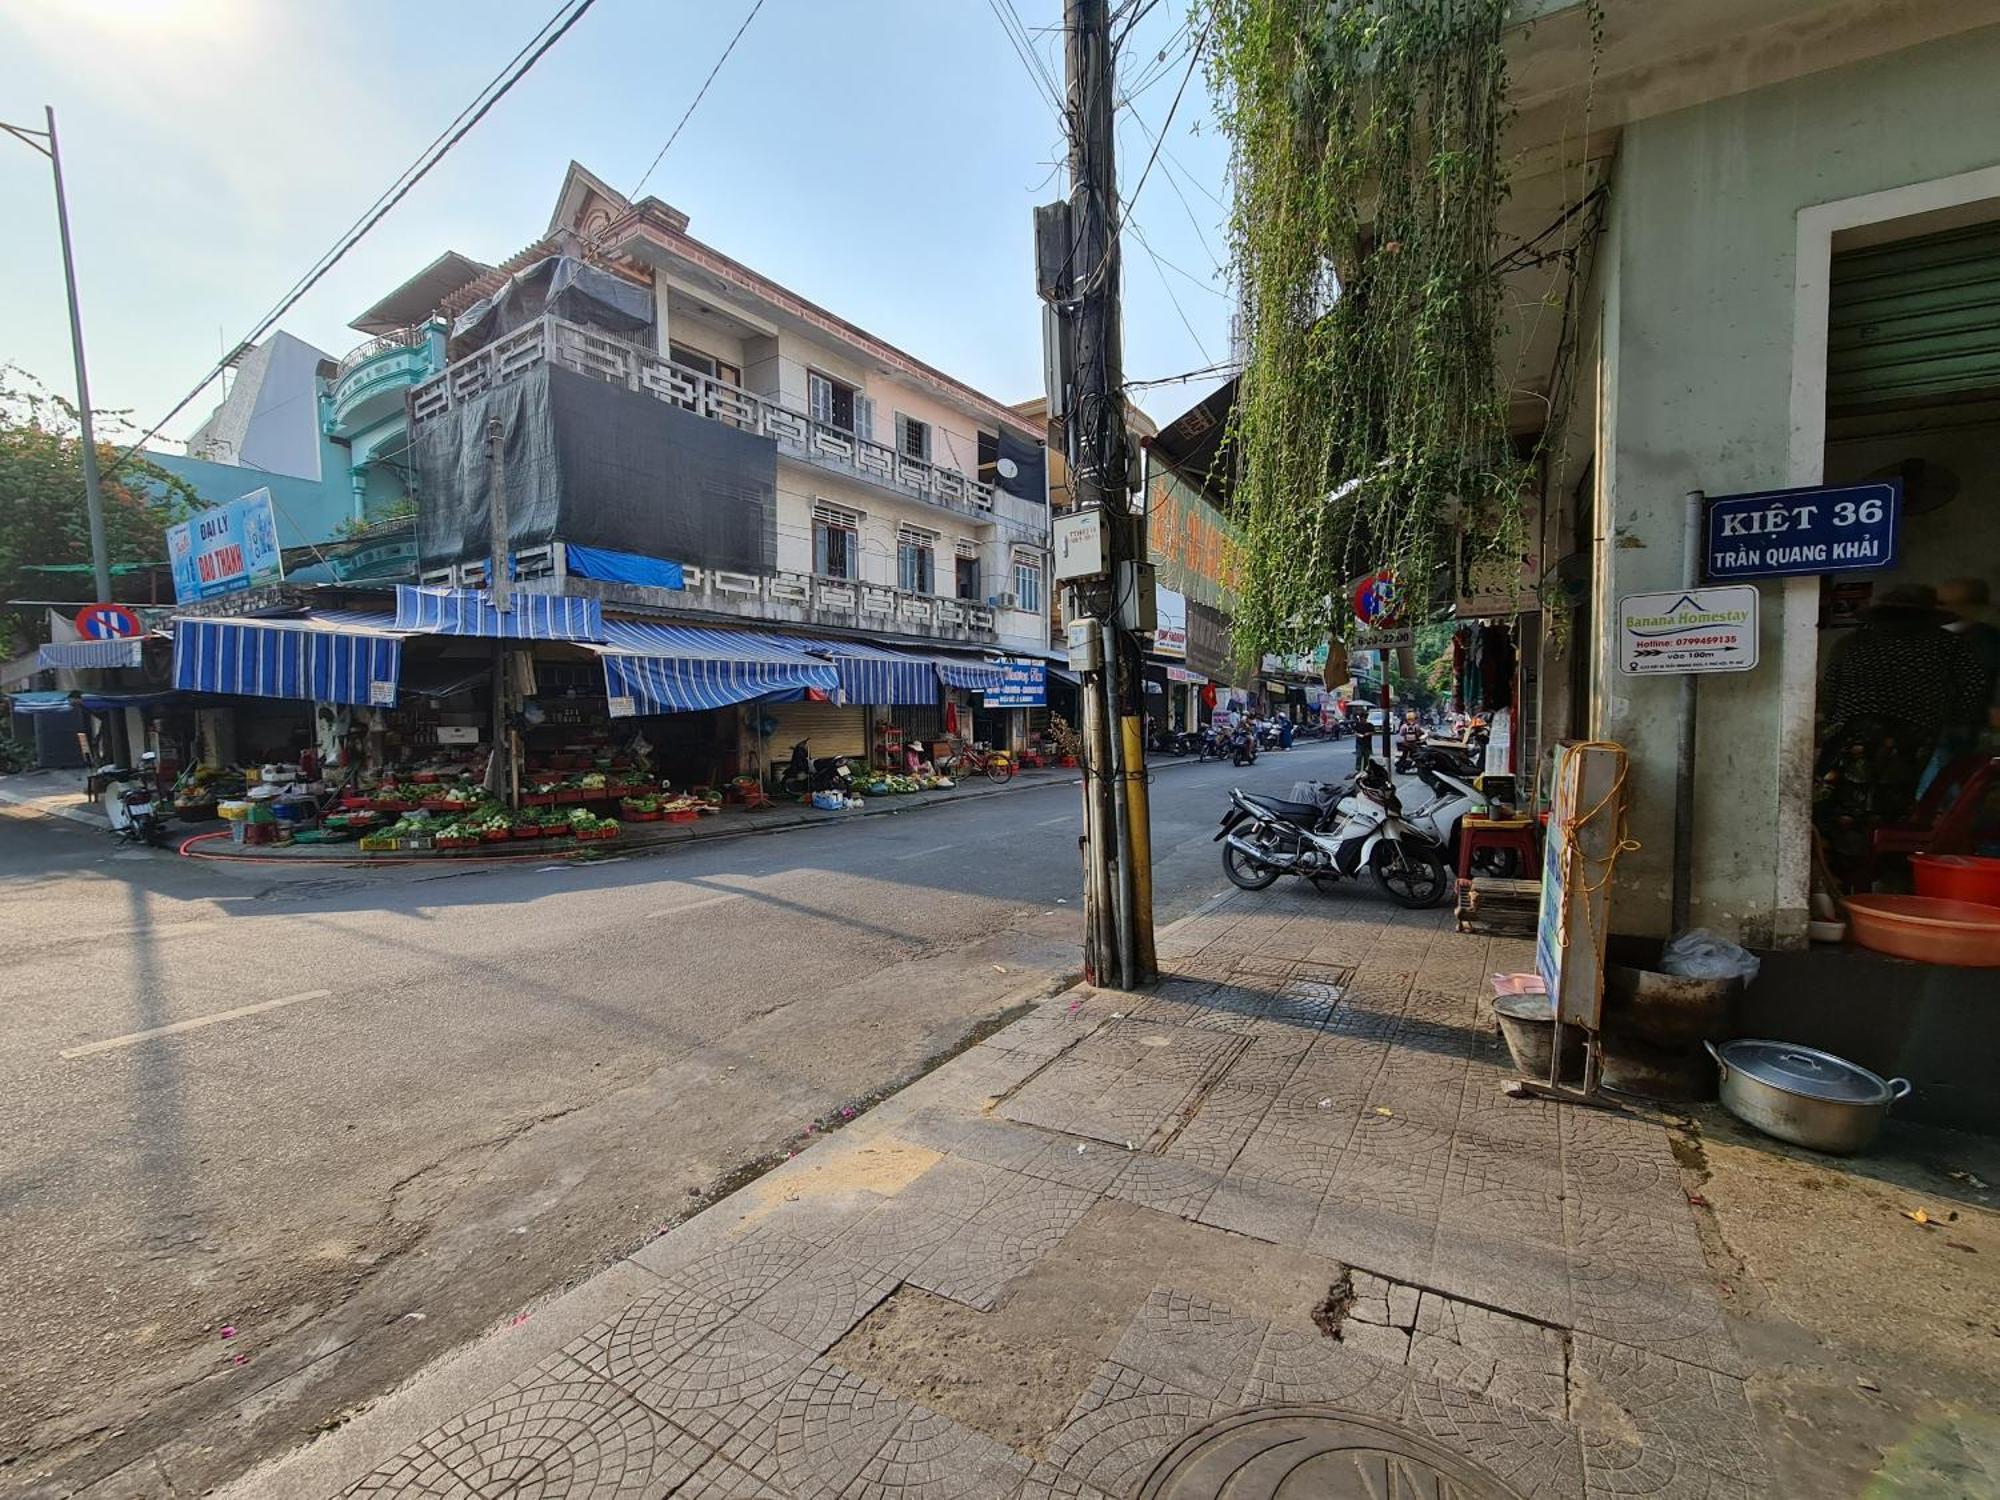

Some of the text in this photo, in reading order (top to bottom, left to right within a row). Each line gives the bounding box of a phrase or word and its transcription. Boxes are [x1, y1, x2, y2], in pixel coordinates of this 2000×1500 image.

[1721, 499, 1883, 539] KIỆT 36
[1714, 534, 1879, 568] TRẦN QUANG KHẢI
[1625, 609, 1749, 628] Banana Homestay
[1636, 639, 1673, 649] Hotline:
